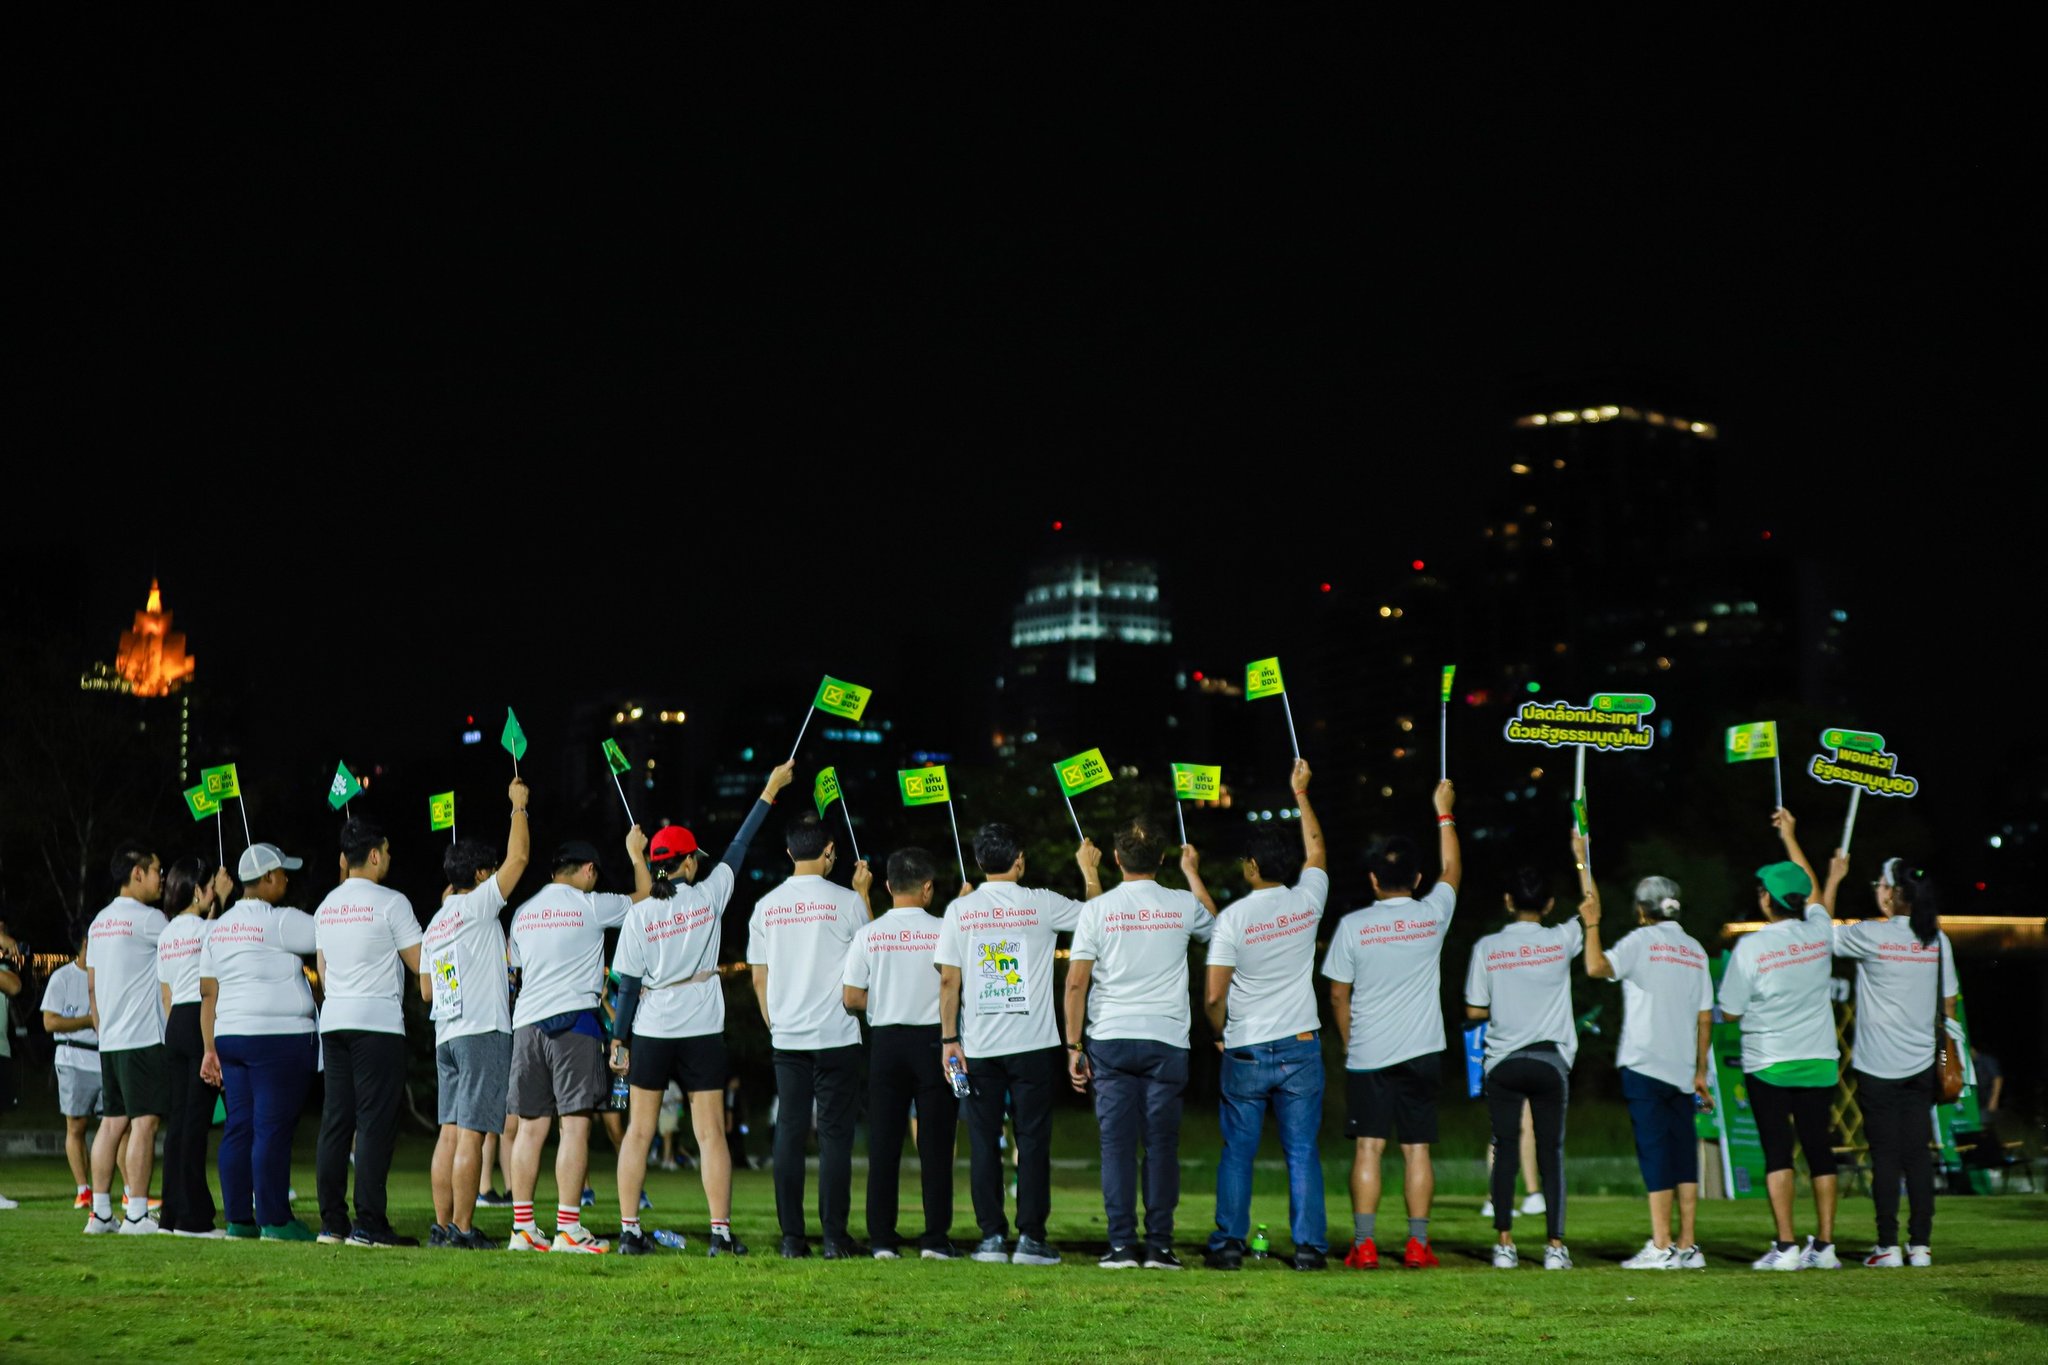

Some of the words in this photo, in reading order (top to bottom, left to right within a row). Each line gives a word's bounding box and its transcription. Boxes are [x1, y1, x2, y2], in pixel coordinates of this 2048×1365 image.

[1523, 704, 1638, 725] ปลดล็อกประเทศ
[1508, 723, 1650, 747] ด้วยรัฐธรรมนูญใหม่
[1082, 758, 1098, 770] เห็น
[1838, 748, 1893, 770] พอแล้ว!
[925, 773, 942, 784] เห็น
[1085, 766, 1103, 778] ชอบ
[1813, 758, 1914, 794] รัฐธรรมนูญ60
[825, 784, 837, 794] ชอ
[925, 784, 945, 793] ชอบ
[765, 905, 792, 917] เพื่อไทย
[807, 901, 837, 911] เห็นชอบ
[960, 910, 989, 921] เพื่อไทย
[1005, 907, 1037, 917] เห็นชอบ
[1105, 912, 1136, 922] เพื่อไทย
[1152, 909, 1183, 919] เห็นชอบ
[645, 919, 672, 933] เพื่อไทย
[1245, 922, 1275, 935] เพื่อไทย
[1360, 924, 1392, 935] เพื่อไทย
[868, 931, 896, 942] เพื่อไทย
[912, 930, 940, 940] เห็นชอ
[999, 958, 1019, 971] กา
